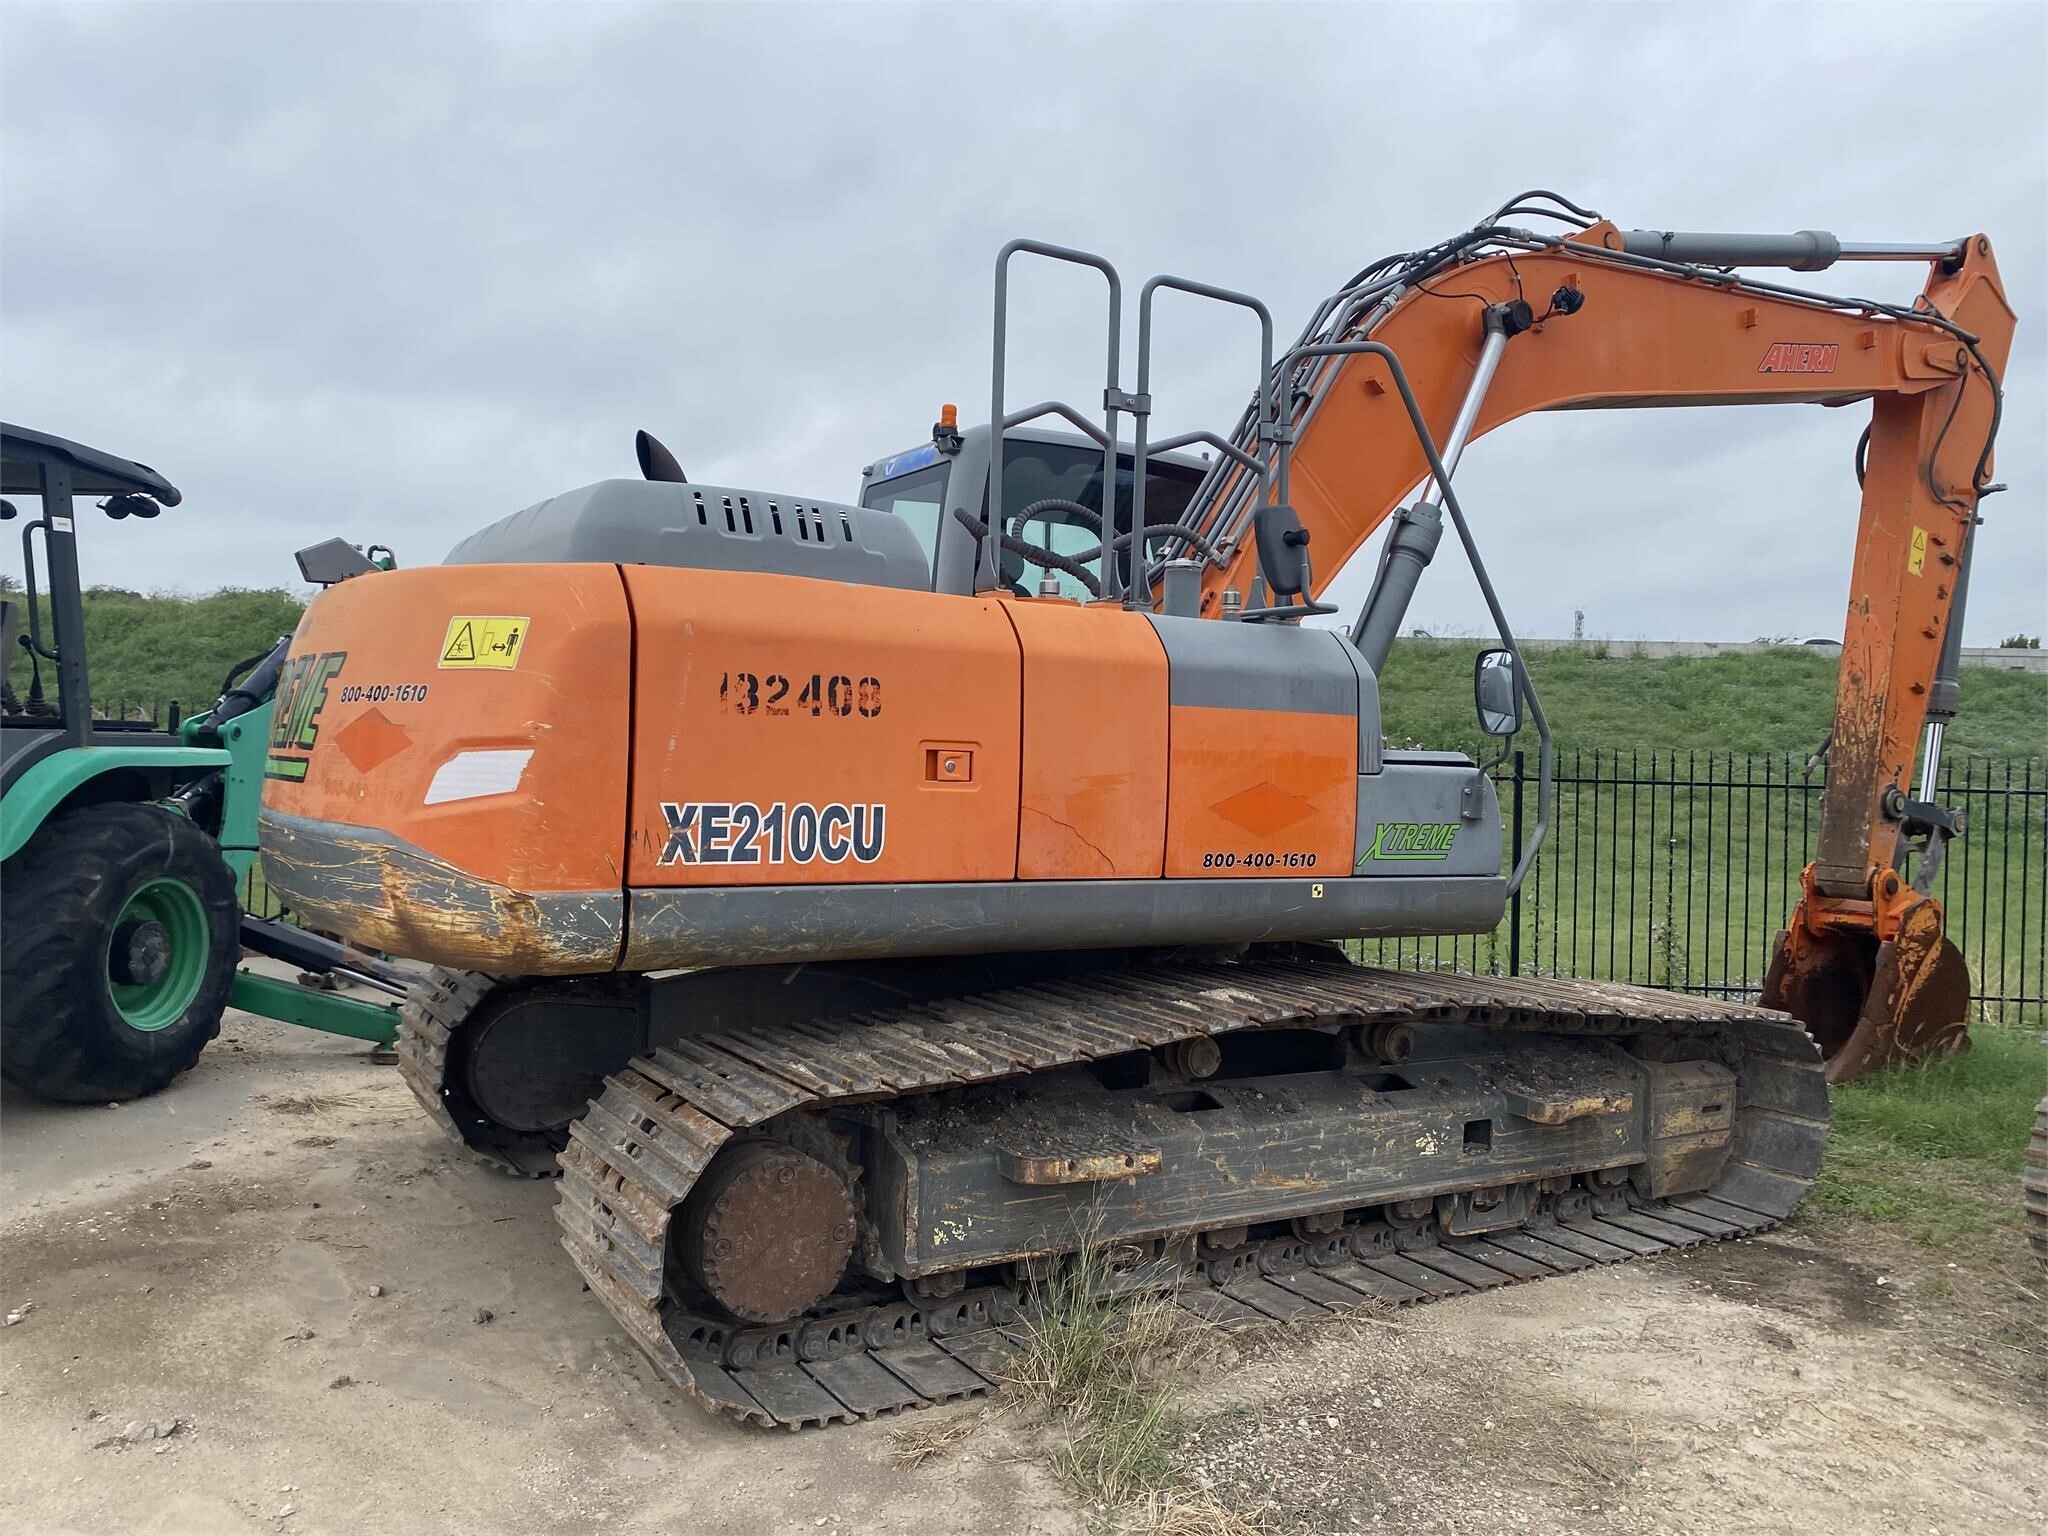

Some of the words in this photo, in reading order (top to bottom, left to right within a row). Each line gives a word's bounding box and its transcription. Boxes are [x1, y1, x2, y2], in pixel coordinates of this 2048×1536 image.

[1758, 343, 1839, 373] AHERN
[340, 684, 428, 704] 800-400-1610
[657, 802, 886, 866] XE210CU
[1356, 823, 1461, 867] XTREME
[1202, 853, 1317, 869] 800-400-1610
